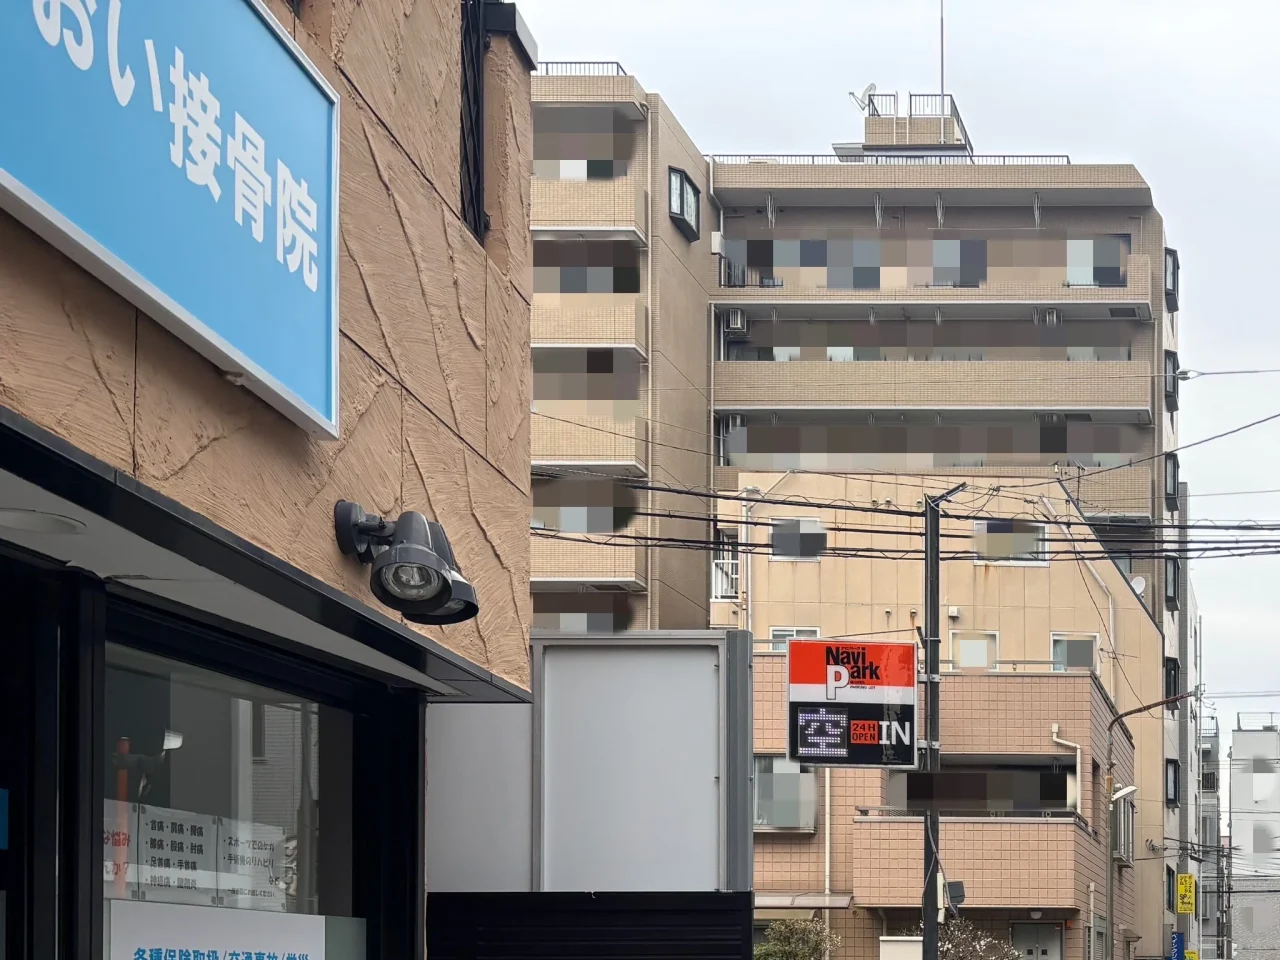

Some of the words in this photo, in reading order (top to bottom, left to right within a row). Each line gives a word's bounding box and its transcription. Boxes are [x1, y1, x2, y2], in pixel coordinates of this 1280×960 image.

[826, 646, 866, 665] Navi
[826, 661, 880, 700] Park
[799, 708, 848, 755] 空
[852, 732, 876, 742] OPEN
[879, 721, 911, 746] IN
